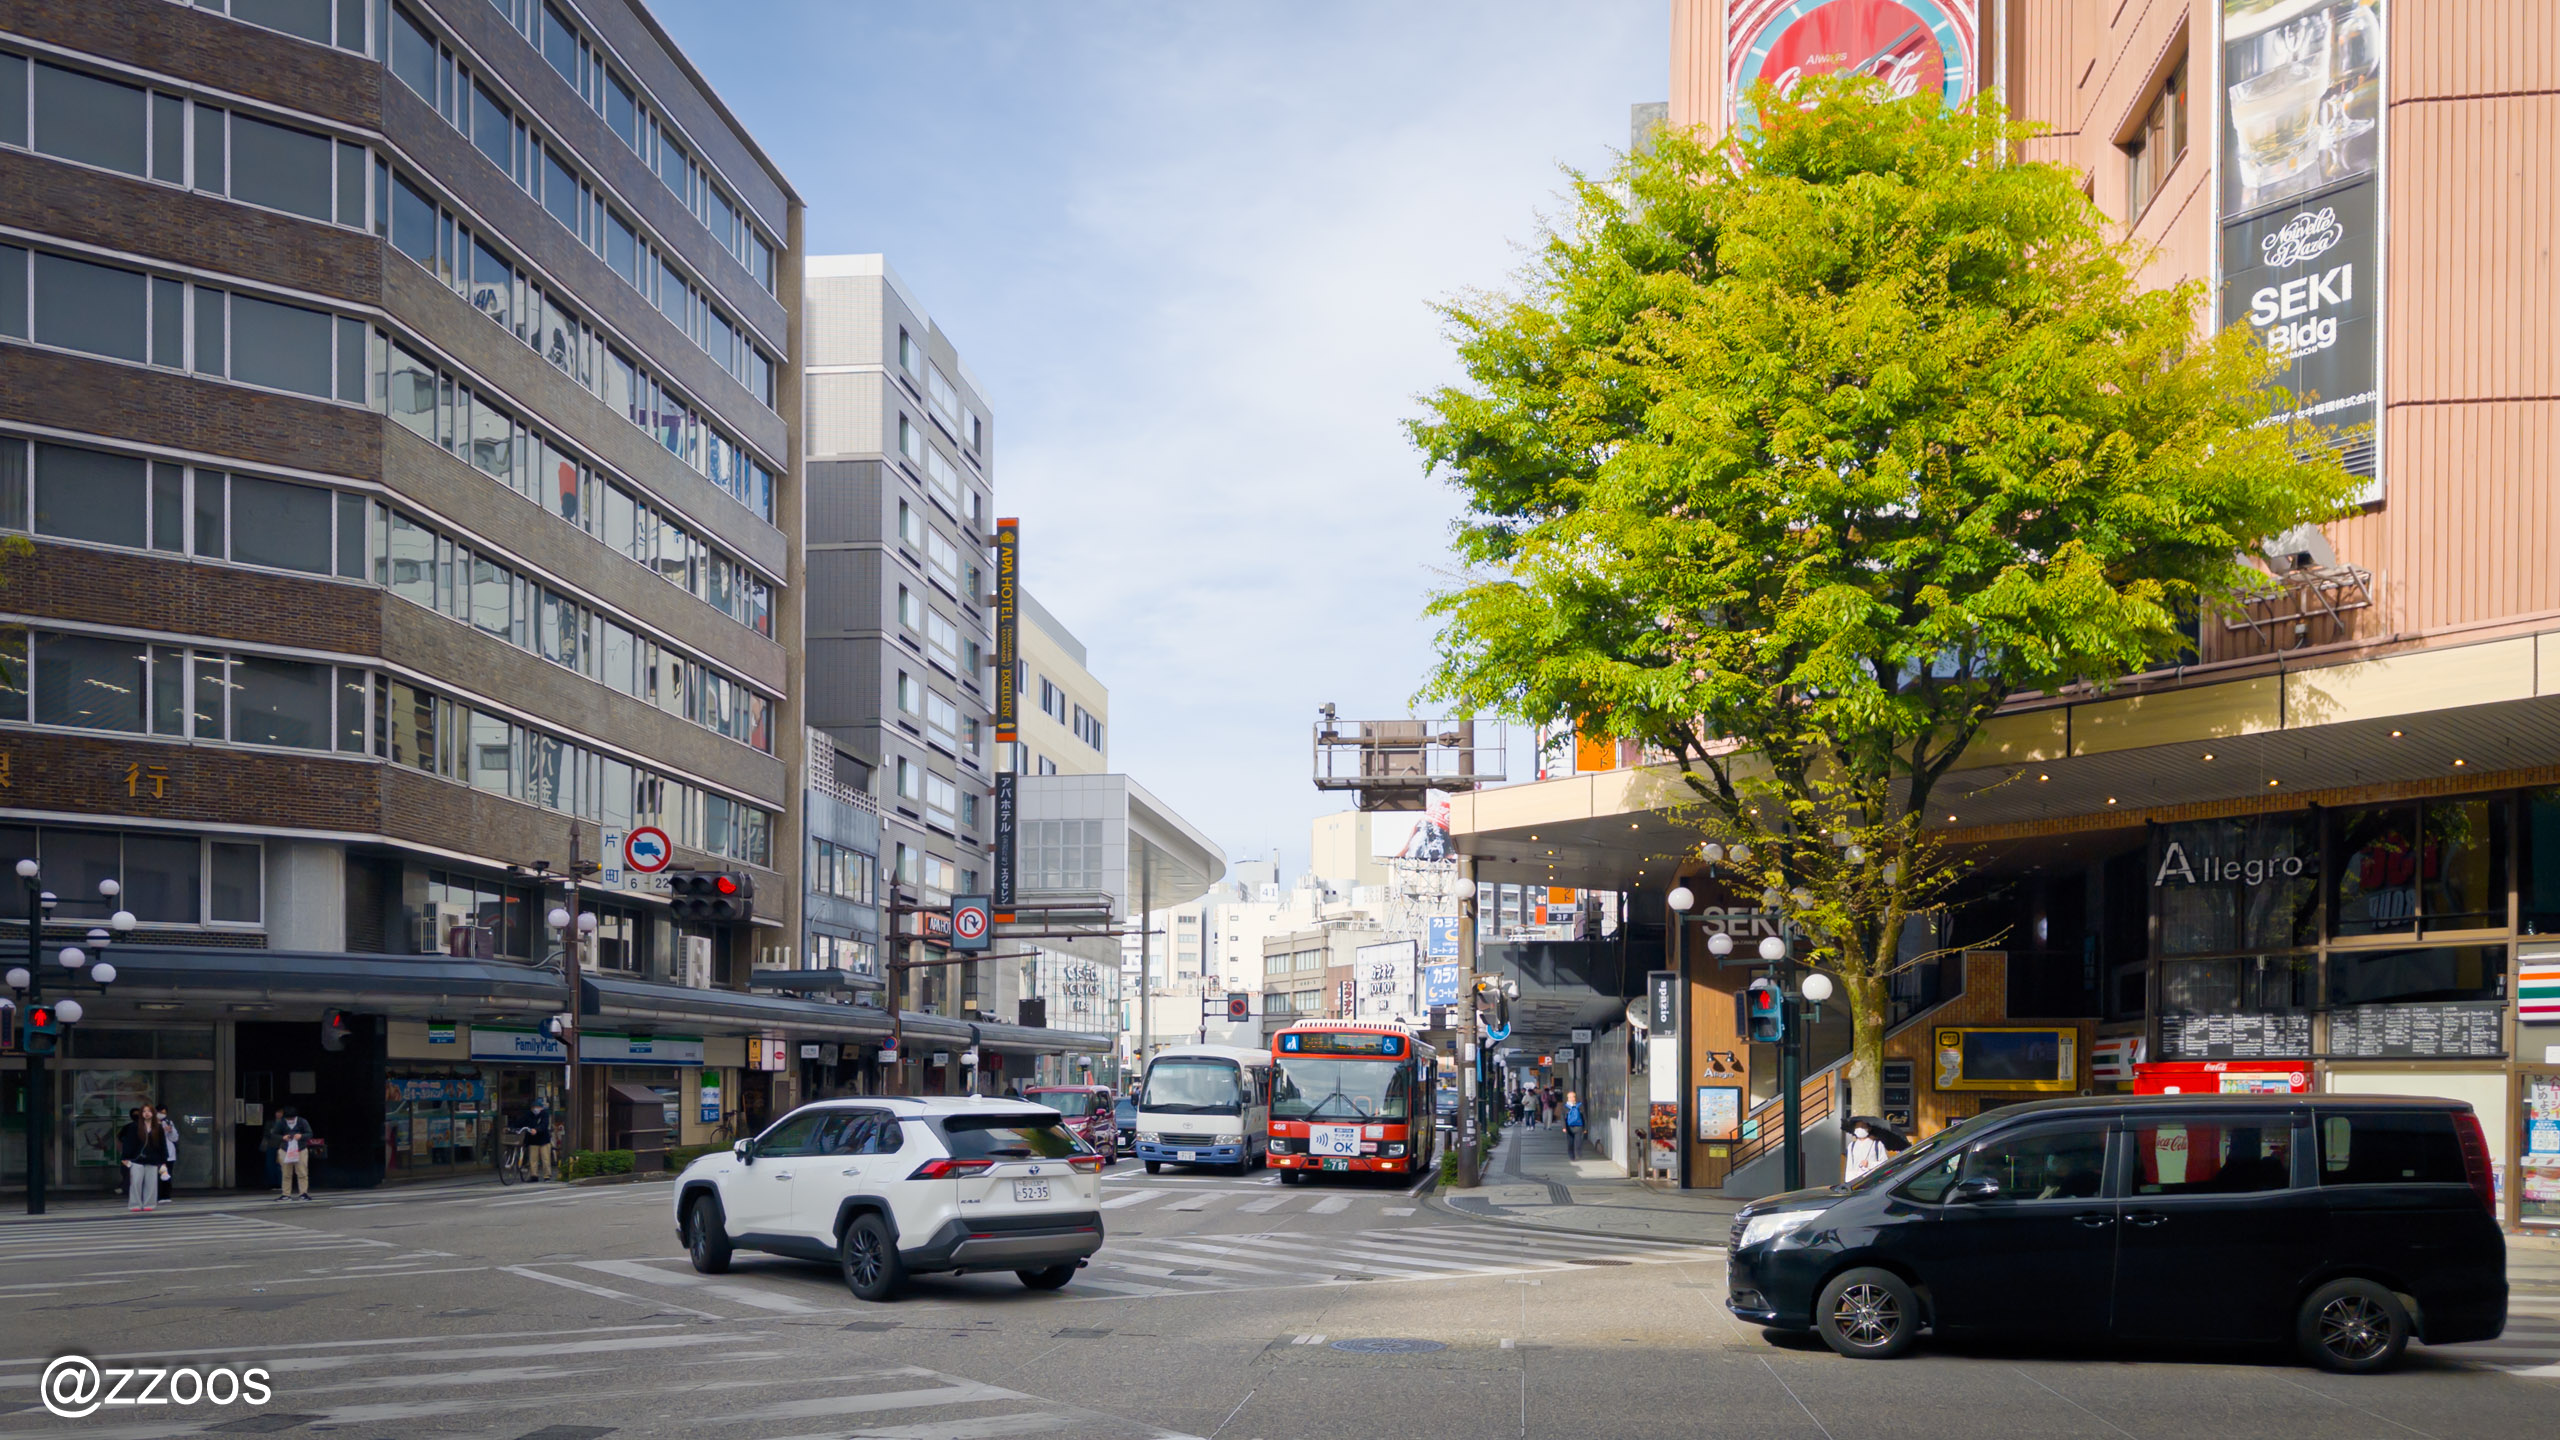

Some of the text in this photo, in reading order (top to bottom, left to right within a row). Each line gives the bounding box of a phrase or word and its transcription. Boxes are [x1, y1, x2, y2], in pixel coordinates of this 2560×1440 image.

[2250, 263, 2352, 326] SEKI
[2267, 316, 2337, 355] Bldg
[1001, 547, 1013, 623] APA HOTEL
[1000, 777, 1011, 833] アパホテル
[605, 834, 619, 883] 片町
[2154, 842, 2303, 887] Allegro
[1344, 981, 1352, 1016] カラオケ
[1659, 981, 1669, 1023] spazio
[515, 1037, 558, 1054] FamilyMart
[1334, 1142, 1353, 1153] OK
[1022, 1187, 1048, 1199] 52-35
